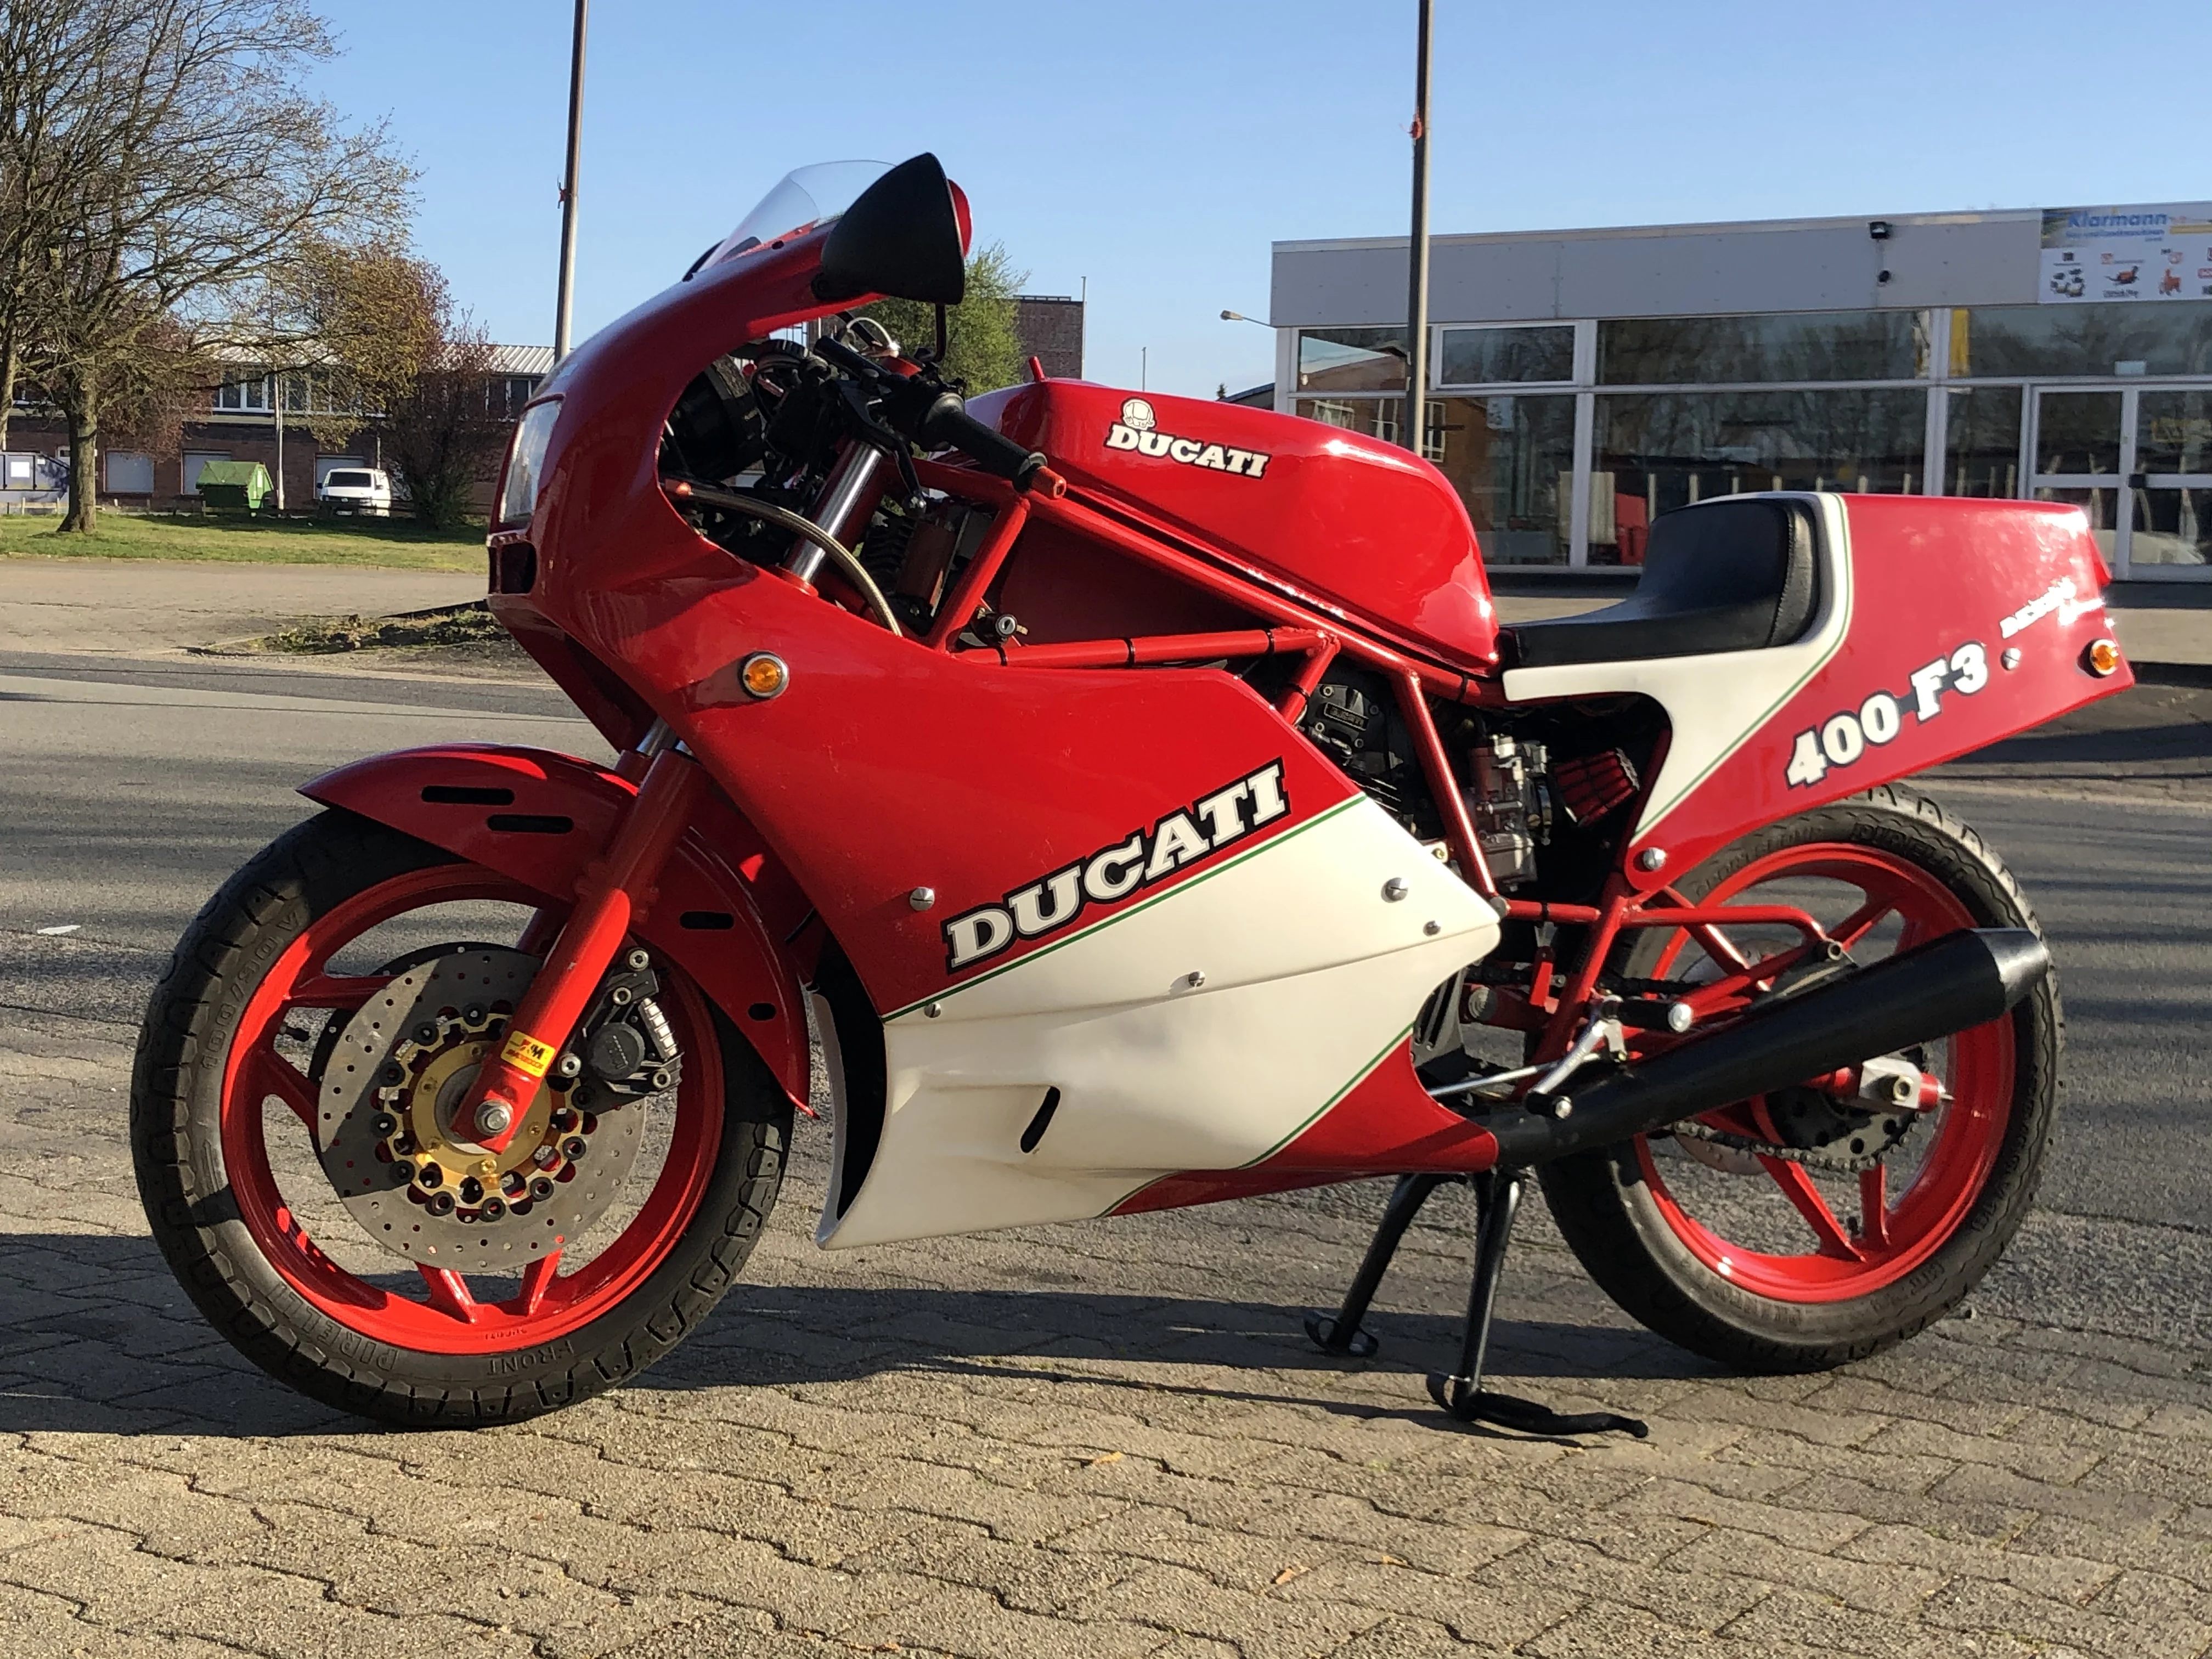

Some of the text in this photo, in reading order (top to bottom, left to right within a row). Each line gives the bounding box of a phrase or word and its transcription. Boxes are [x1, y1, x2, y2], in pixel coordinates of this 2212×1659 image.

[2067, 211, 2166, 227] Klarmann
[1106, 424, 1269, 477] DUCATI
[1787, 643, 1988, 787] 400 F3
[946, 763, 1286, 969] DUCATI
[267, 1282, 398, 1372] PIRELLI
